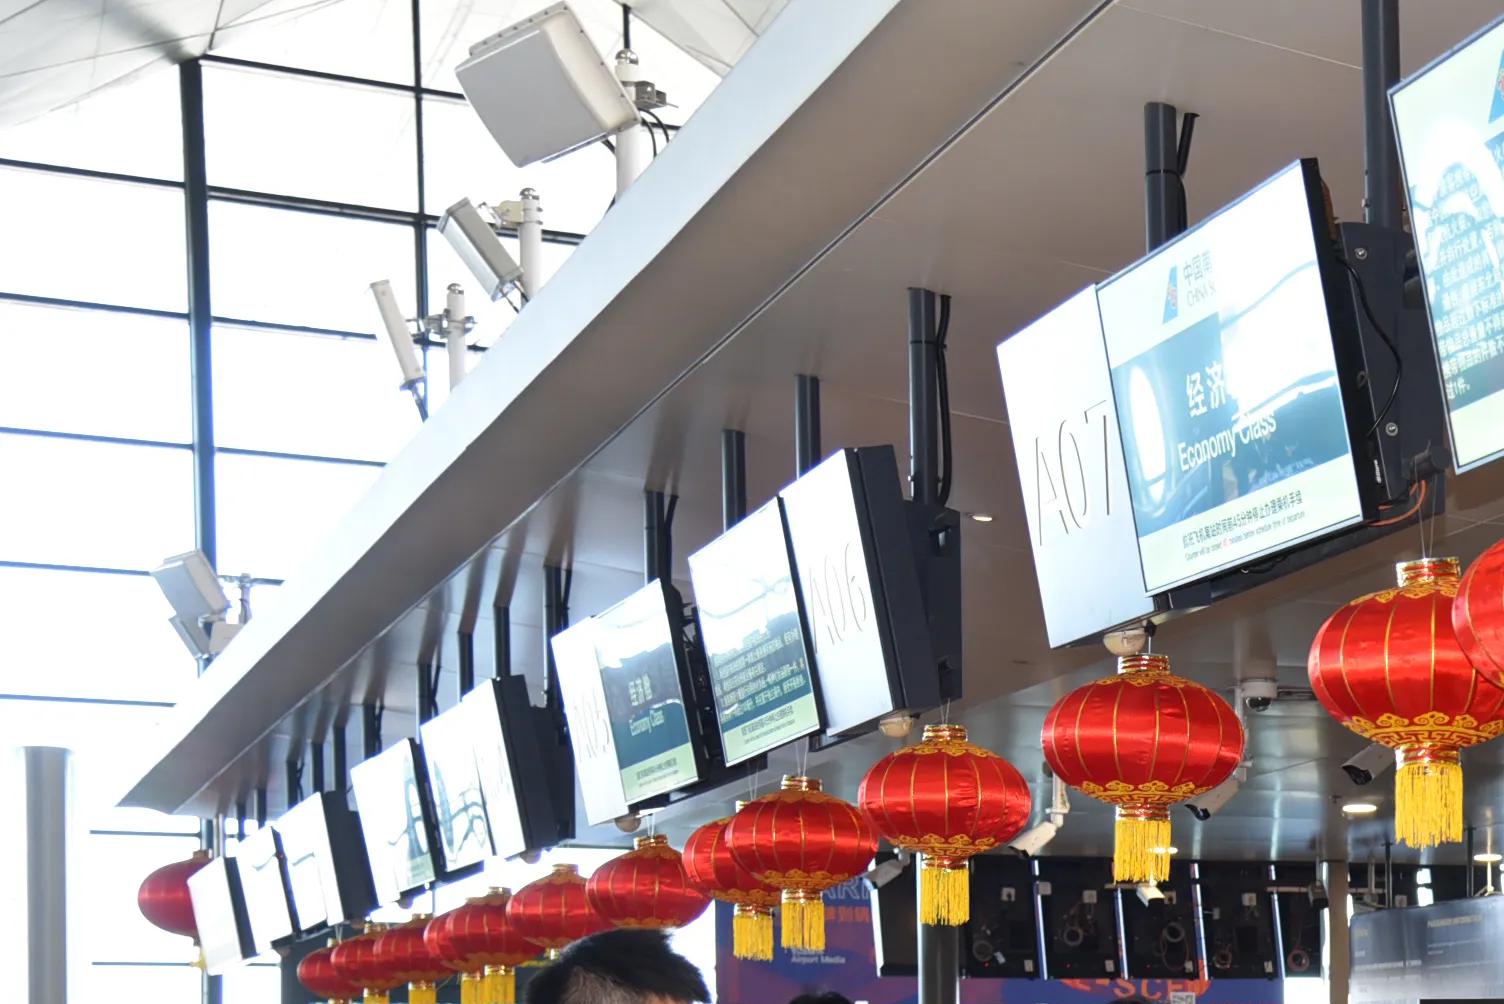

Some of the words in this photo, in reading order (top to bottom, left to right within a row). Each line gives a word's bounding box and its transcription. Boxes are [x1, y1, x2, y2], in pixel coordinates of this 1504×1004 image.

[1178, 423, 1236, 472] Economy
[1235, 412, 1277, 446] Class
[1036, 400, 1113, 546] A07
[791, 955, 819, 965] Airport
[821, 954, 846, 964] Media
